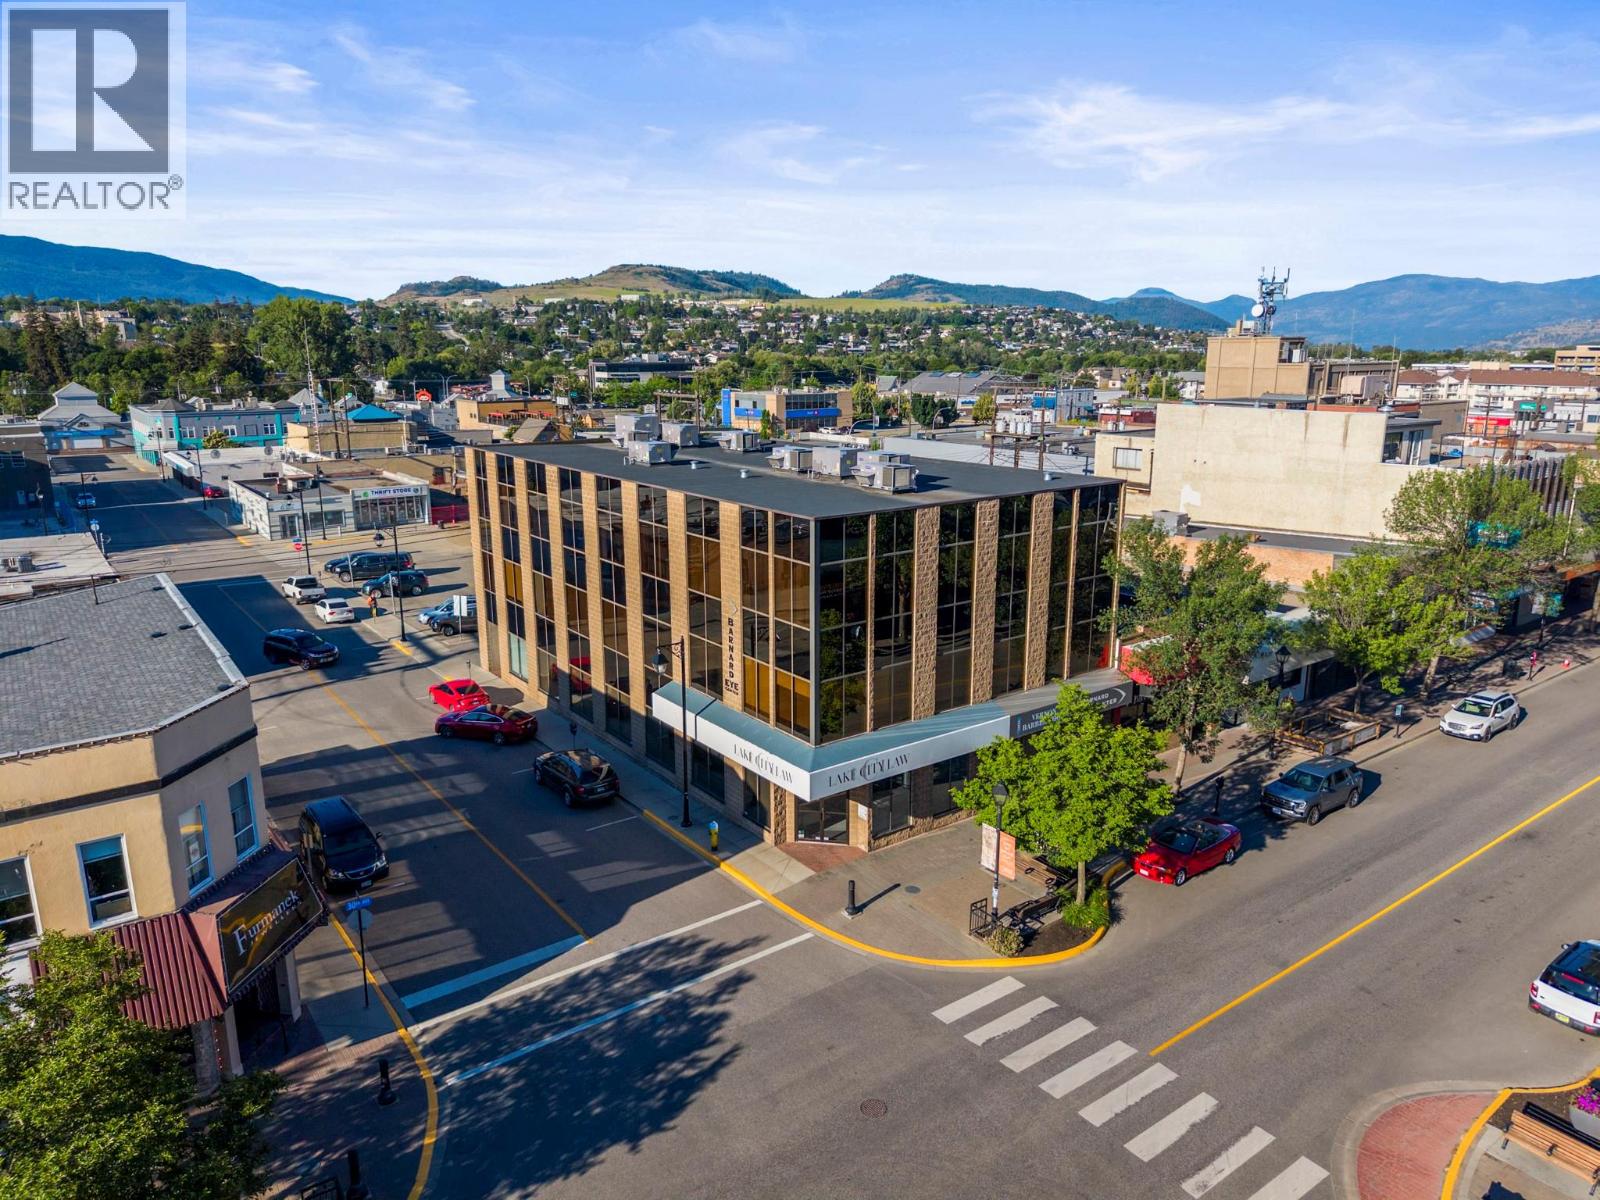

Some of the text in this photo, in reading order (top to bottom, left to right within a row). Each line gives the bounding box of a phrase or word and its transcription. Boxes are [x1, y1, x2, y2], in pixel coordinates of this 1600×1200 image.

[724, 679, 739, 691] EYE
[734, 743, 794, 784] LAKE CITY LAW
[828, 752, 910, 788] LAKE CITY LAW
